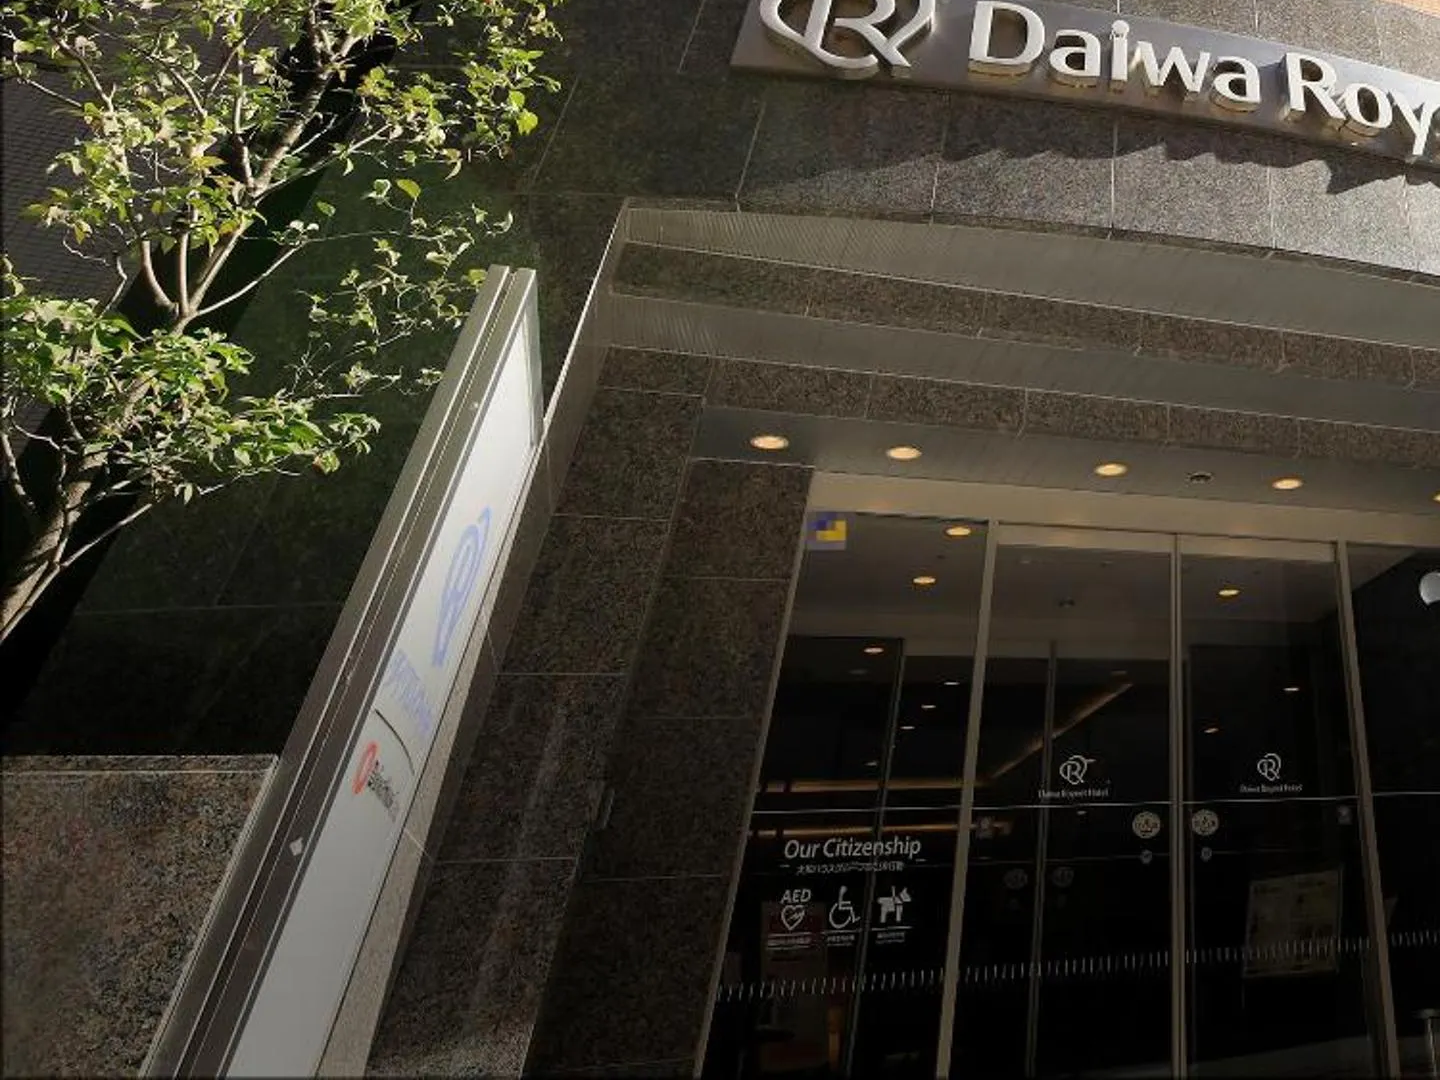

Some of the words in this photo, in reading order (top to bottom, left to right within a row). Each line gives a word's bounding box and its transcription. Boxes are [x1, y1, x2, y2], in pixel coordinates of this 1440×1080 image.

[969, 0, 1262, 106] Daiwa
[784, 839, 821, 860] Our
[822, 835, 922, 861] Citizenship
[780, 888, 812, 904] AED
